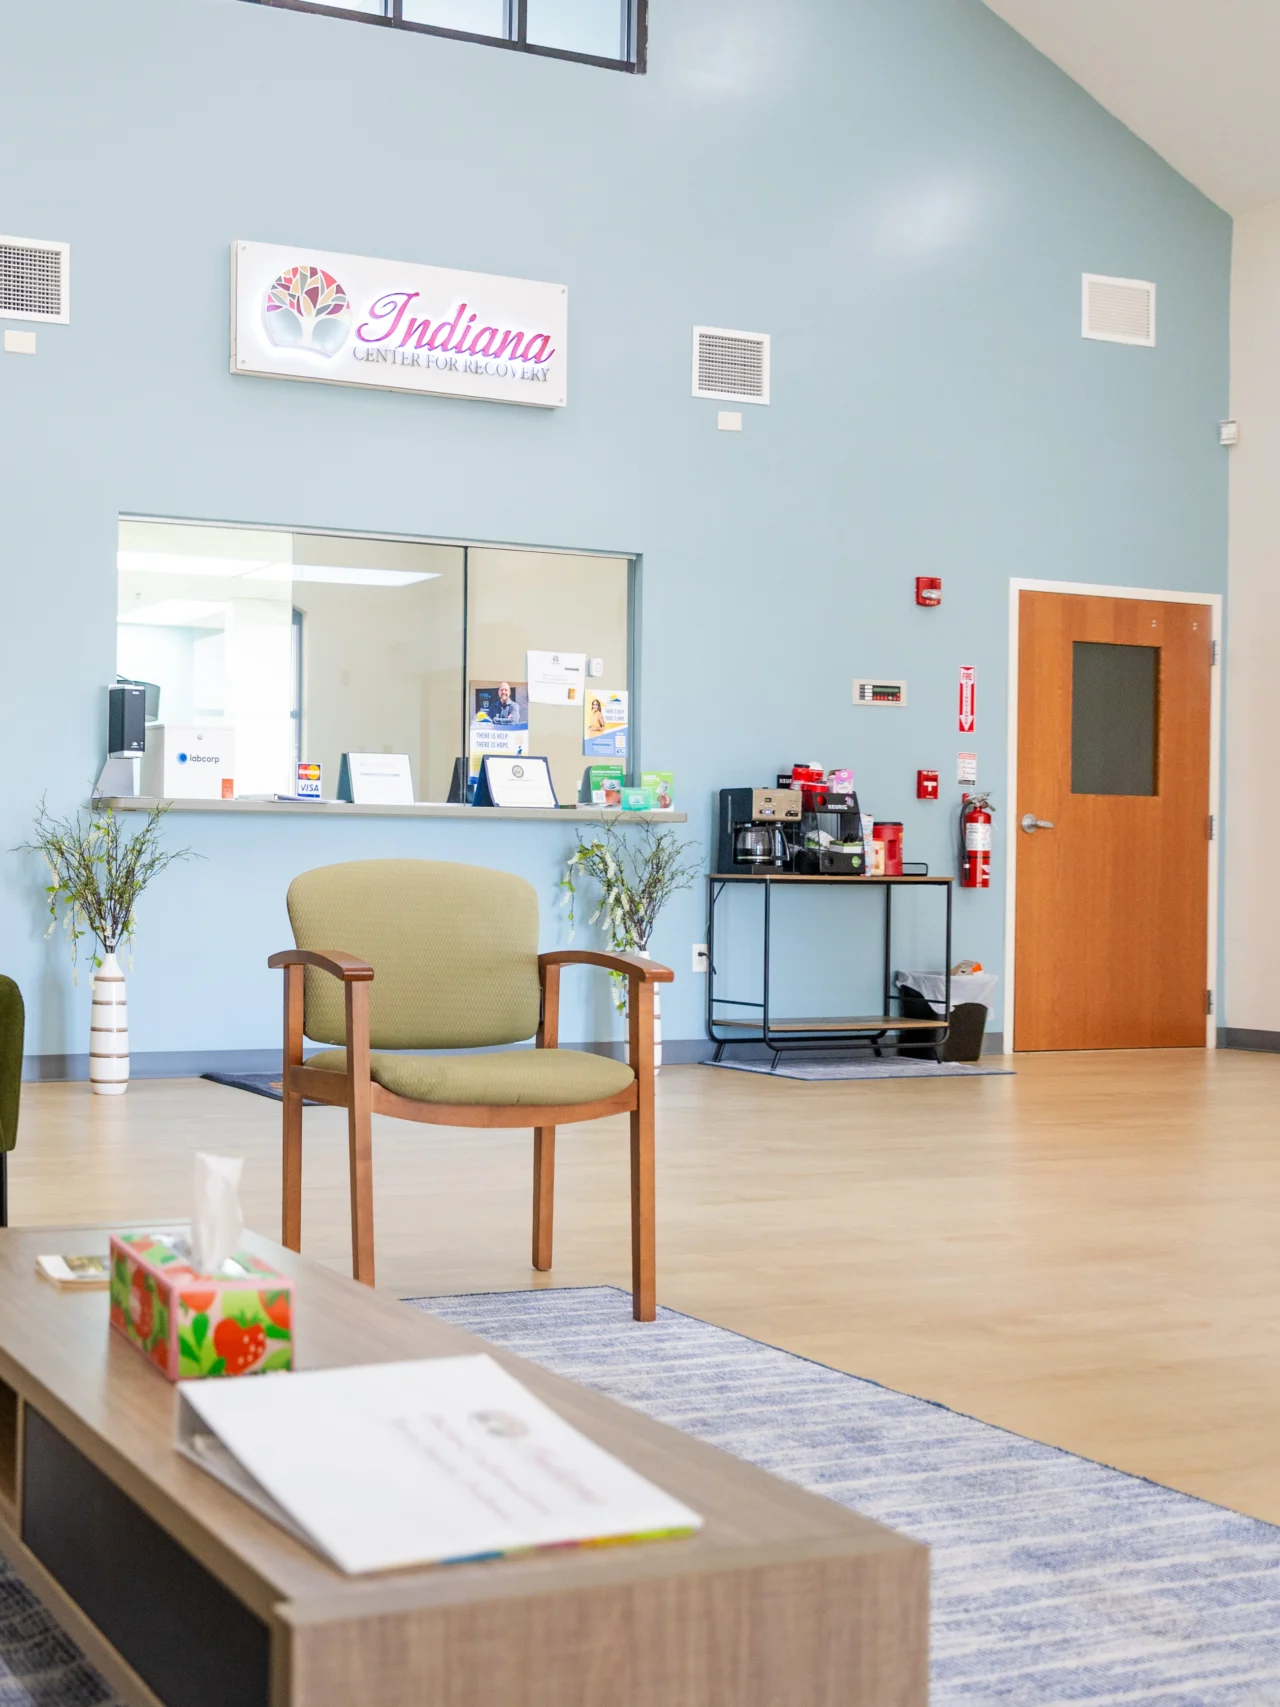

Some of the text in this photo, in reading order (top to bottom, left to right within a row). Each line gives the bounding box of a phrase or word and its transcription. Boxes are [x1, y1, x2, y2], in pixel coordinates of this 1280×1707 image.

[355, 291, 556, 365] Indiana
[353, 346, 551, 383] CENTER FOR RECOVERY
[189, 754, 220, 764] labcorp
[300, 783, 319, 792] VISA
